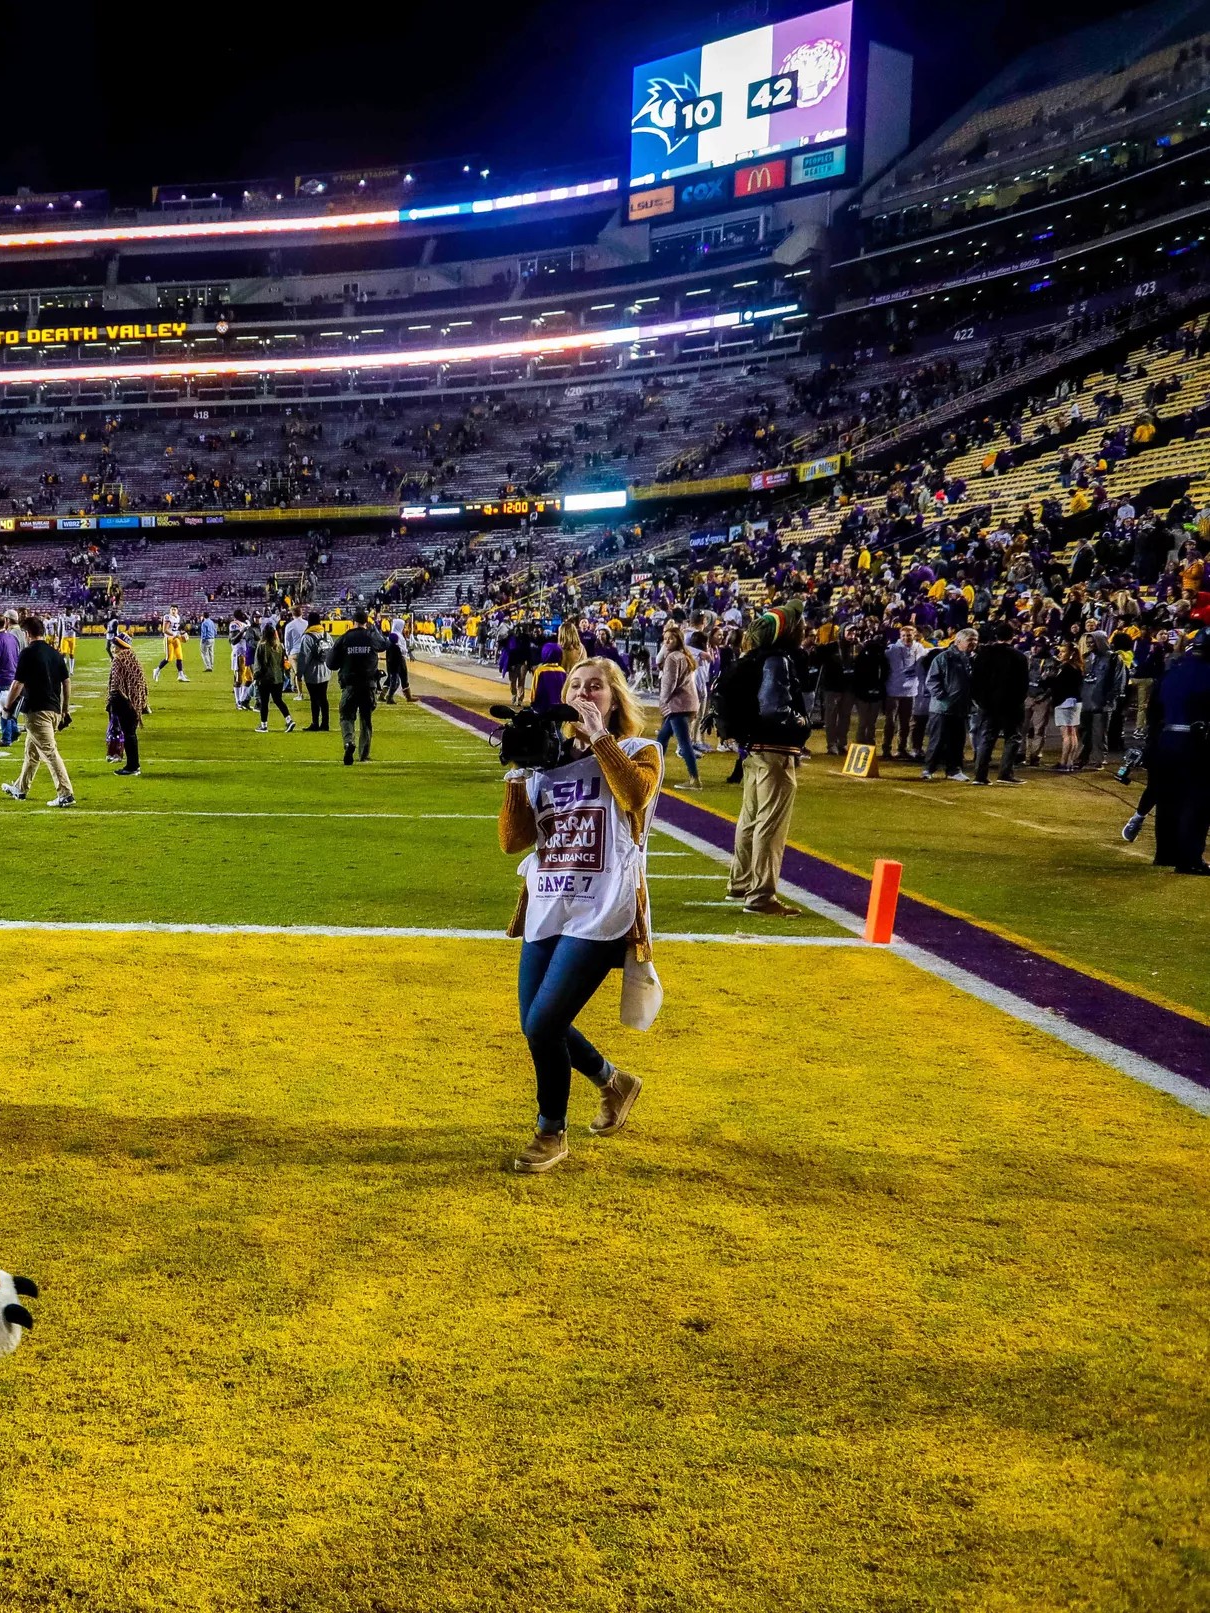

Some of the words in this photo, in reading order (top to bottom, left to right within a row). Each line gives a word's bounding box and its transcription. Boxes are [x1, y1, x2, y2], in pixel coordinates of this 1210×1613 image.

[751, 78, 792, 110] 42
[682, 99, 715, 130] 10
[804, 152, 834, 167] PEOPLES
[682, 176, 725, 203] COX
[1134, 281, 1157, 297] 423
[27, 326, 98, 343] DEATH
[105, 322, 187, 339] VALLEY
[953, 327, 974, 341] 422
[193, 411, 209, 420] 418
[503, 501, 528, 514] 12:00
[0, 519, 12, 530] 40
[347, 646, 371, 655] SHERIFF
[846, 744, 871, 774] 10
[536, 777, 601, 813] LSU
[554, 815, 596, 832] FARM
[544, 852, 596, 863] NSURANCE
[537, 875, 575, 893] GAME
[582, 876, 593, 893] 7
